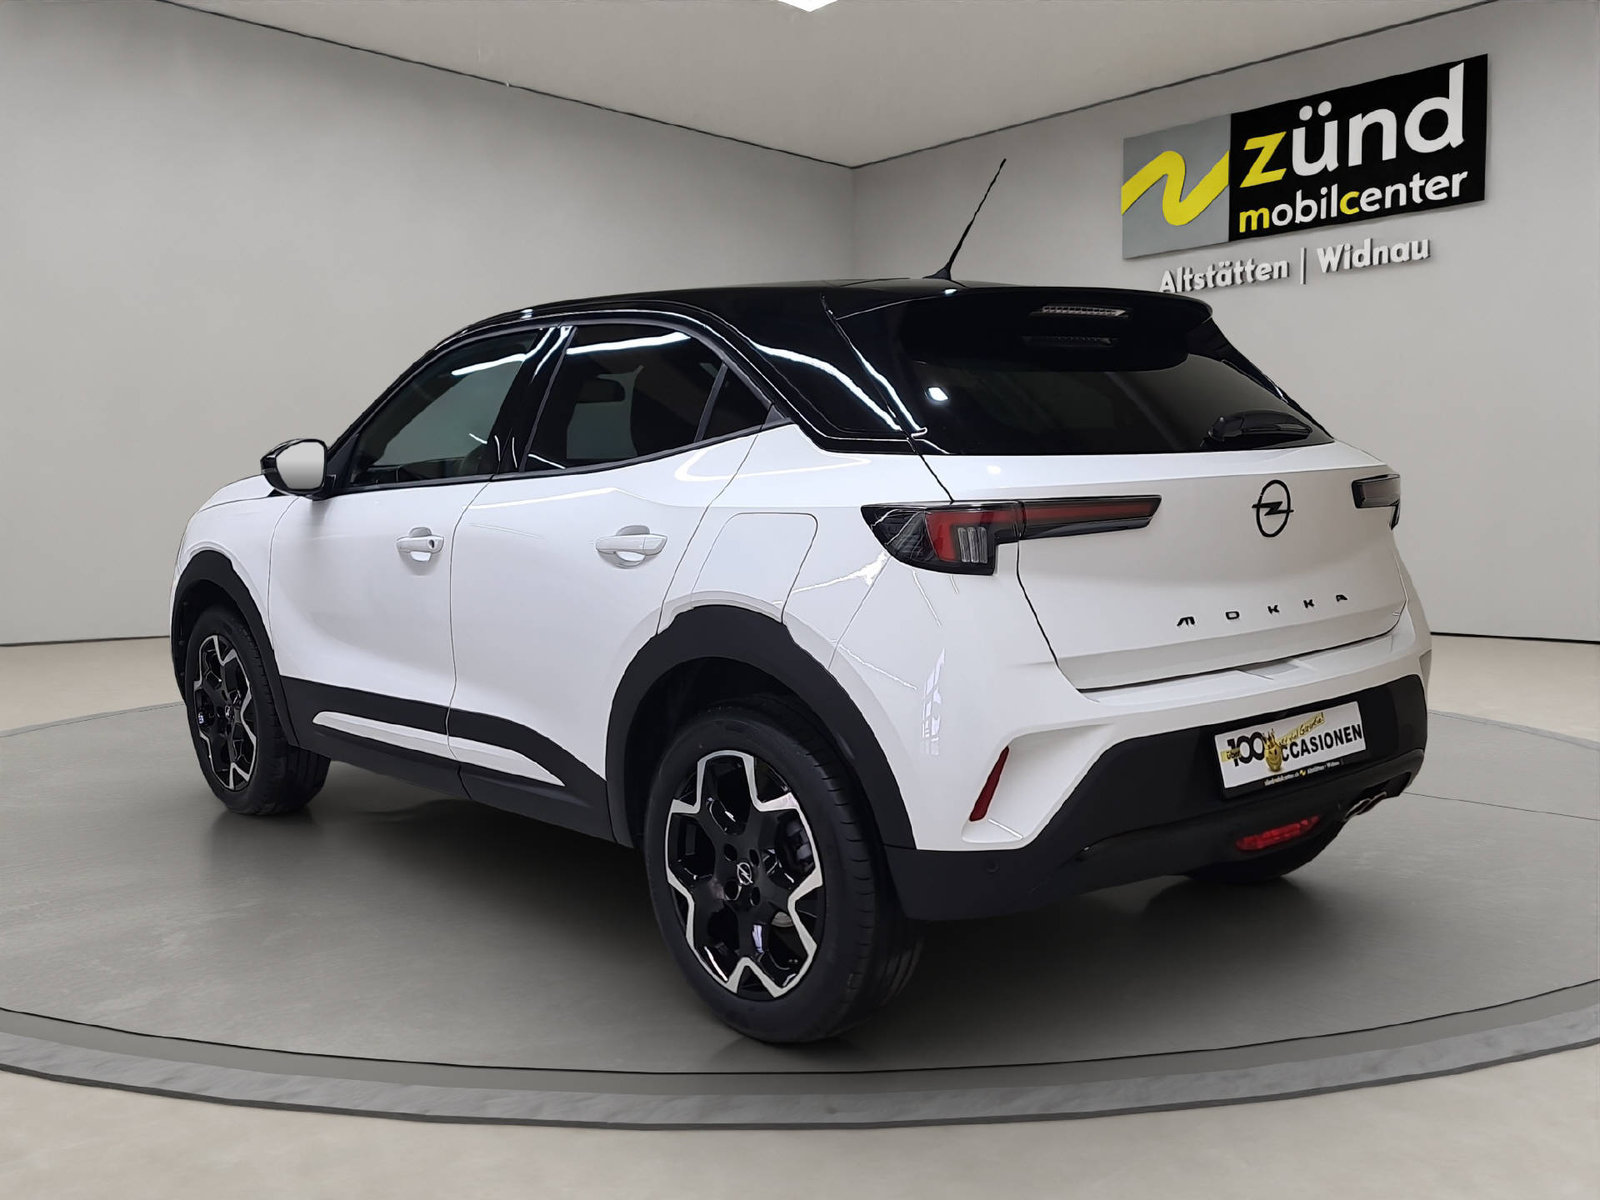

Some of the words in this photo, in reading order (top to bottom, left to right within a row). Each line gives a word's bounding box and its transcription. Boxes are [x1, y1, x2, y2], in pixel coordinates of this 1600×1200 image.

[1240, 62, 1465, 188] zünd
[1239, 171, 1467, 233] mobilcenter
[1159, 258, 1290, 294] Altstätten
[1316, 238, 1430, 273] Widnau
[1177, 594, 1348, 627] MOKKA
